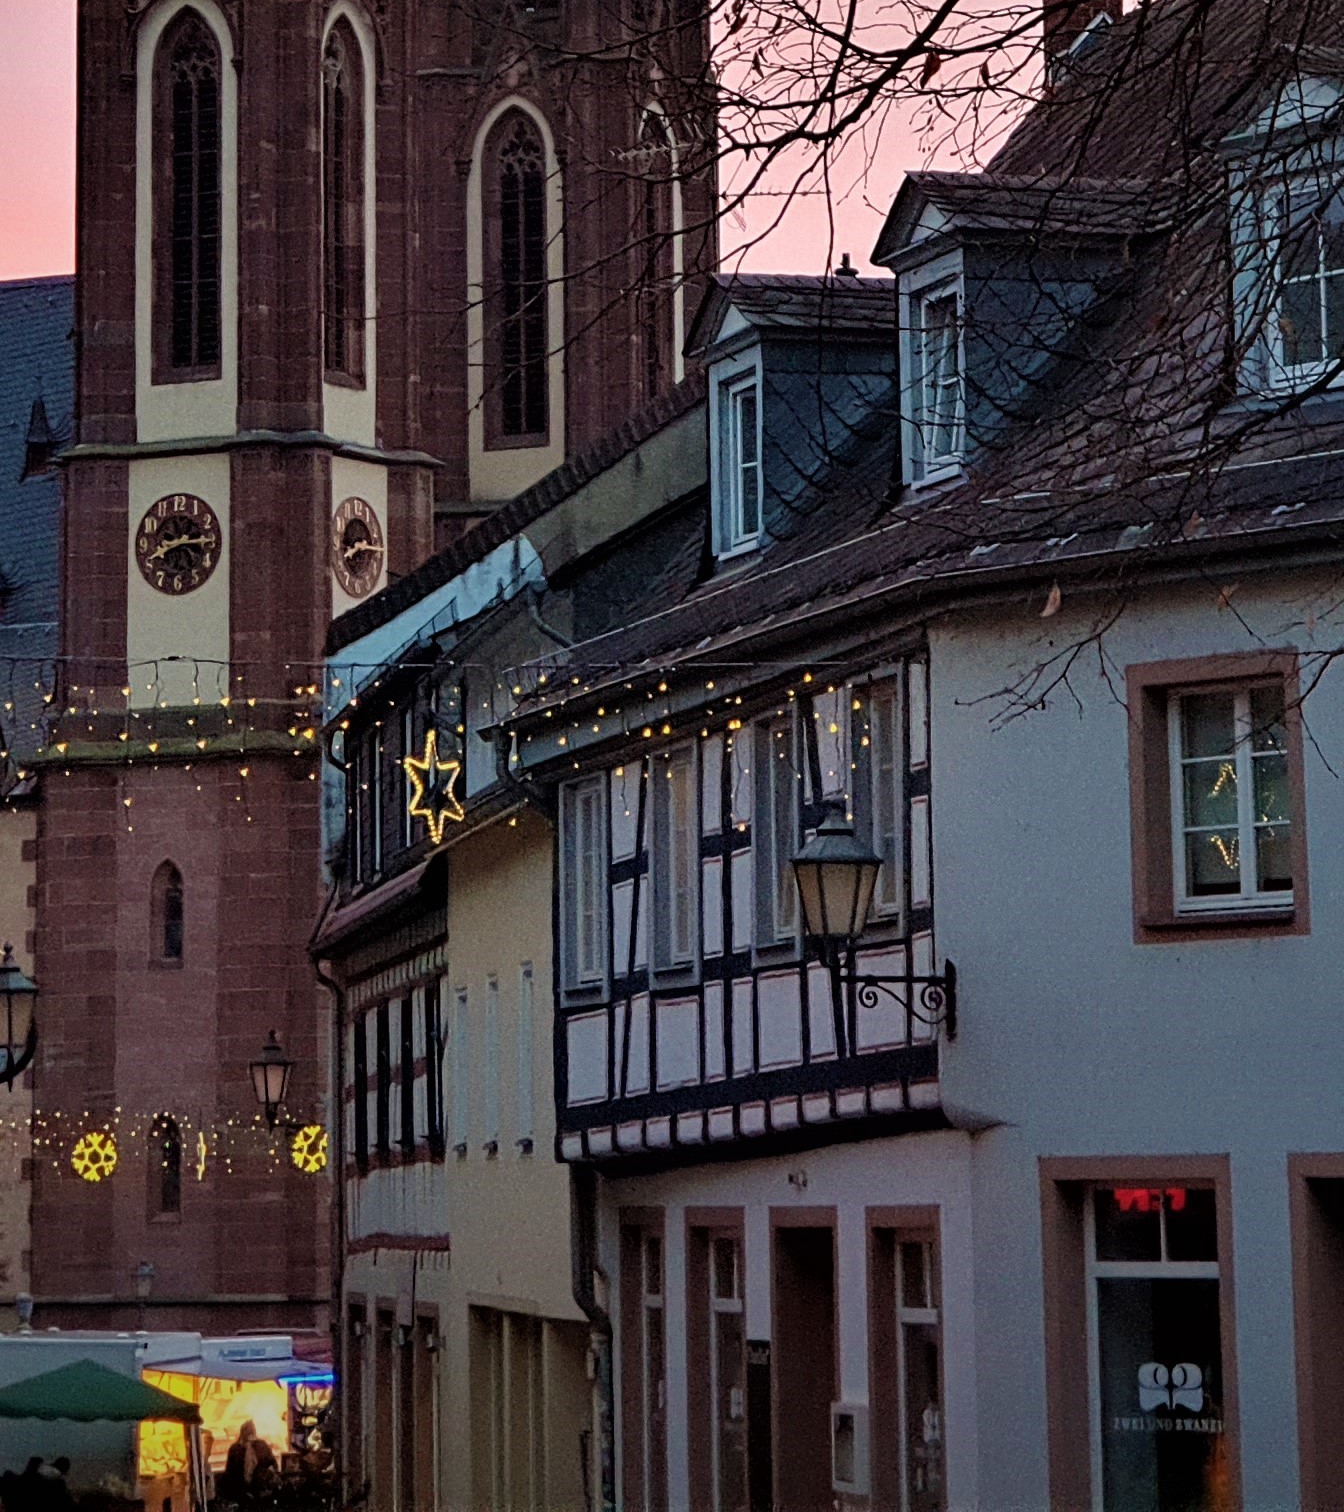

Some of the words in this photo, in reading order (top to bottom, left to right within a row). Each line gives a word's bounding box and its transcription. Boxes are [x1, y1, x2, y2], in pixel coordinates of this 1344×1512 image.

[158, 501, 167, 517] 11
[174, 496, 186, 511] 12
[194, 500, 198, 515] 1
[354, 499, 362, 516] 12
[145, 517, 157, 533] 10
[203, 513, 211, 529] 2
[140, 537, 147, 553] 9
[157, 571, 164, 587] 7
[174, 575, 182, 591] 6
[191, 569, 199, 584] 5
